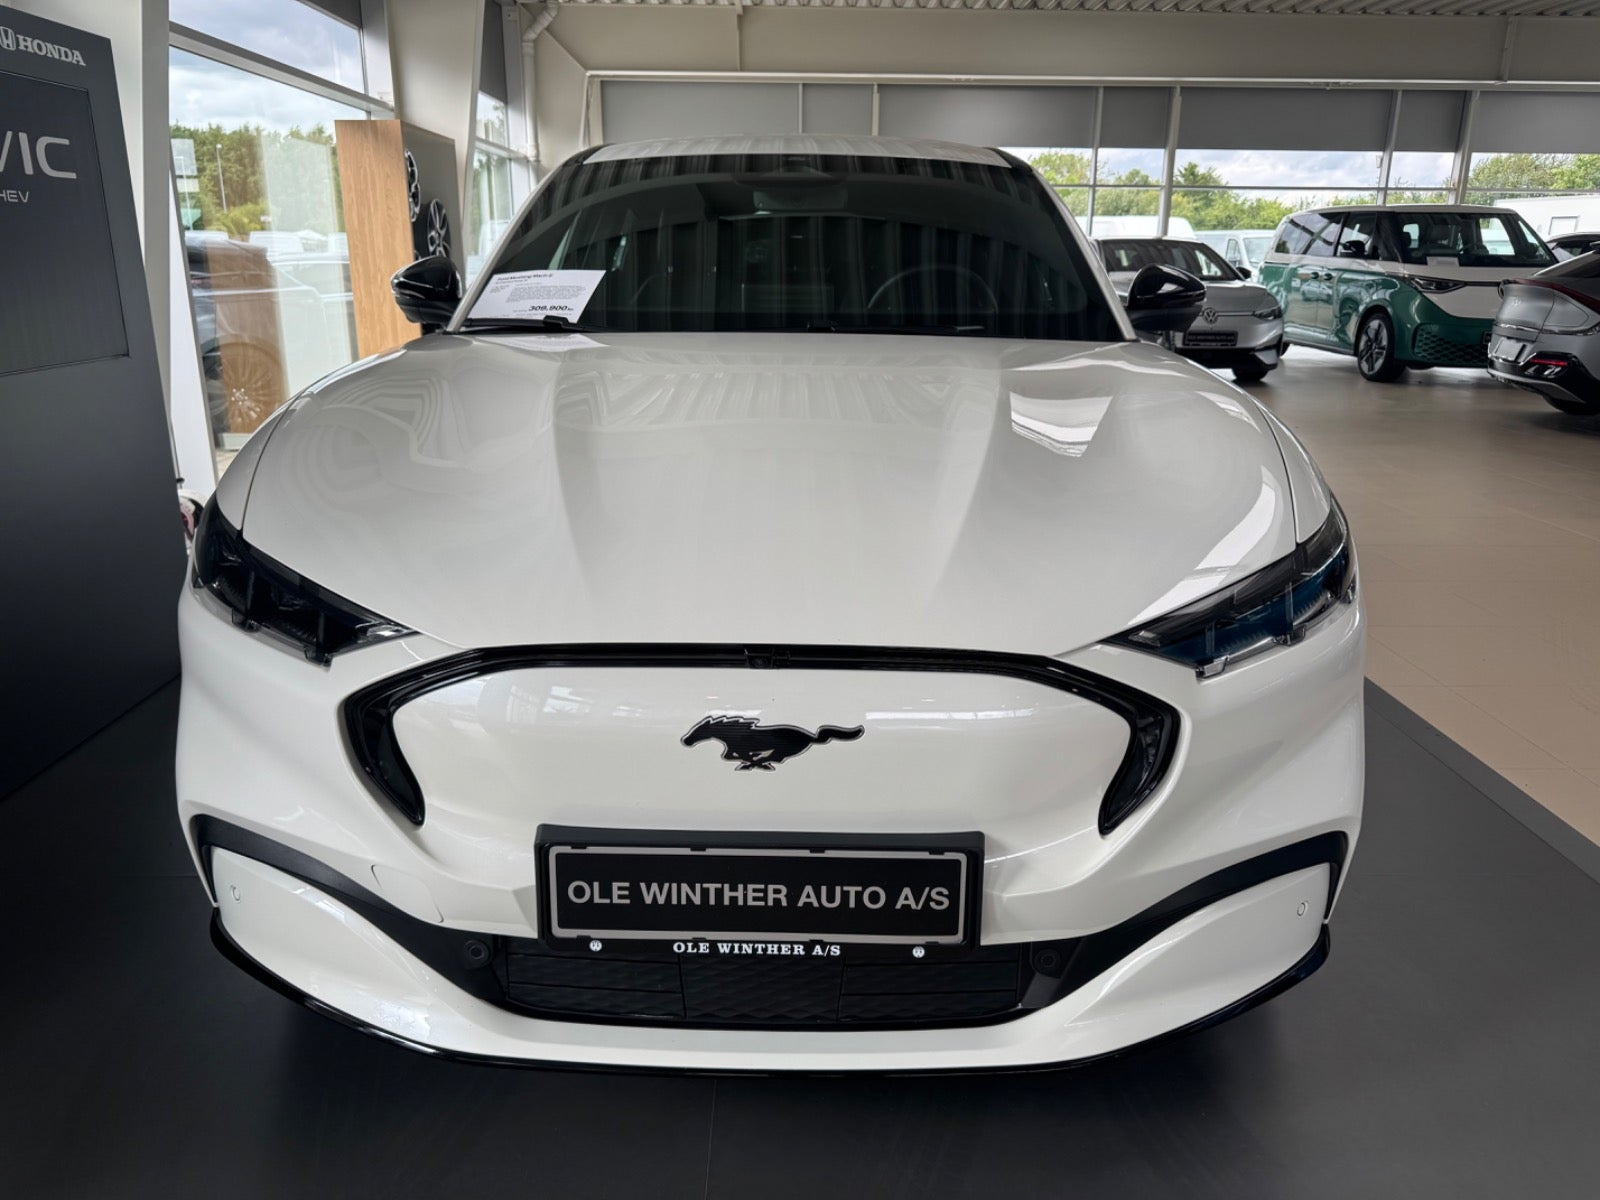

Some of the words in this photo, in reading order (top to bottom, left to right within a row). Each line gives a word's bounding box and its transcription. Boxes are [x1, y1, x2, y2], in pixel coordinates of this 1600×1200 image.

[16, 34, 87, 67] HONDA
[567, 880, 631, 904] OLE
[639, 882, 788, 907] WINTHER
[797, 885, 887, 909] AUTO
[894, 886, 950, 910] A/S
[672, 941, 710, 954] OLE
[716, 942, 806, 956] WINTHER
[811, 944, 841, 957] A/S
